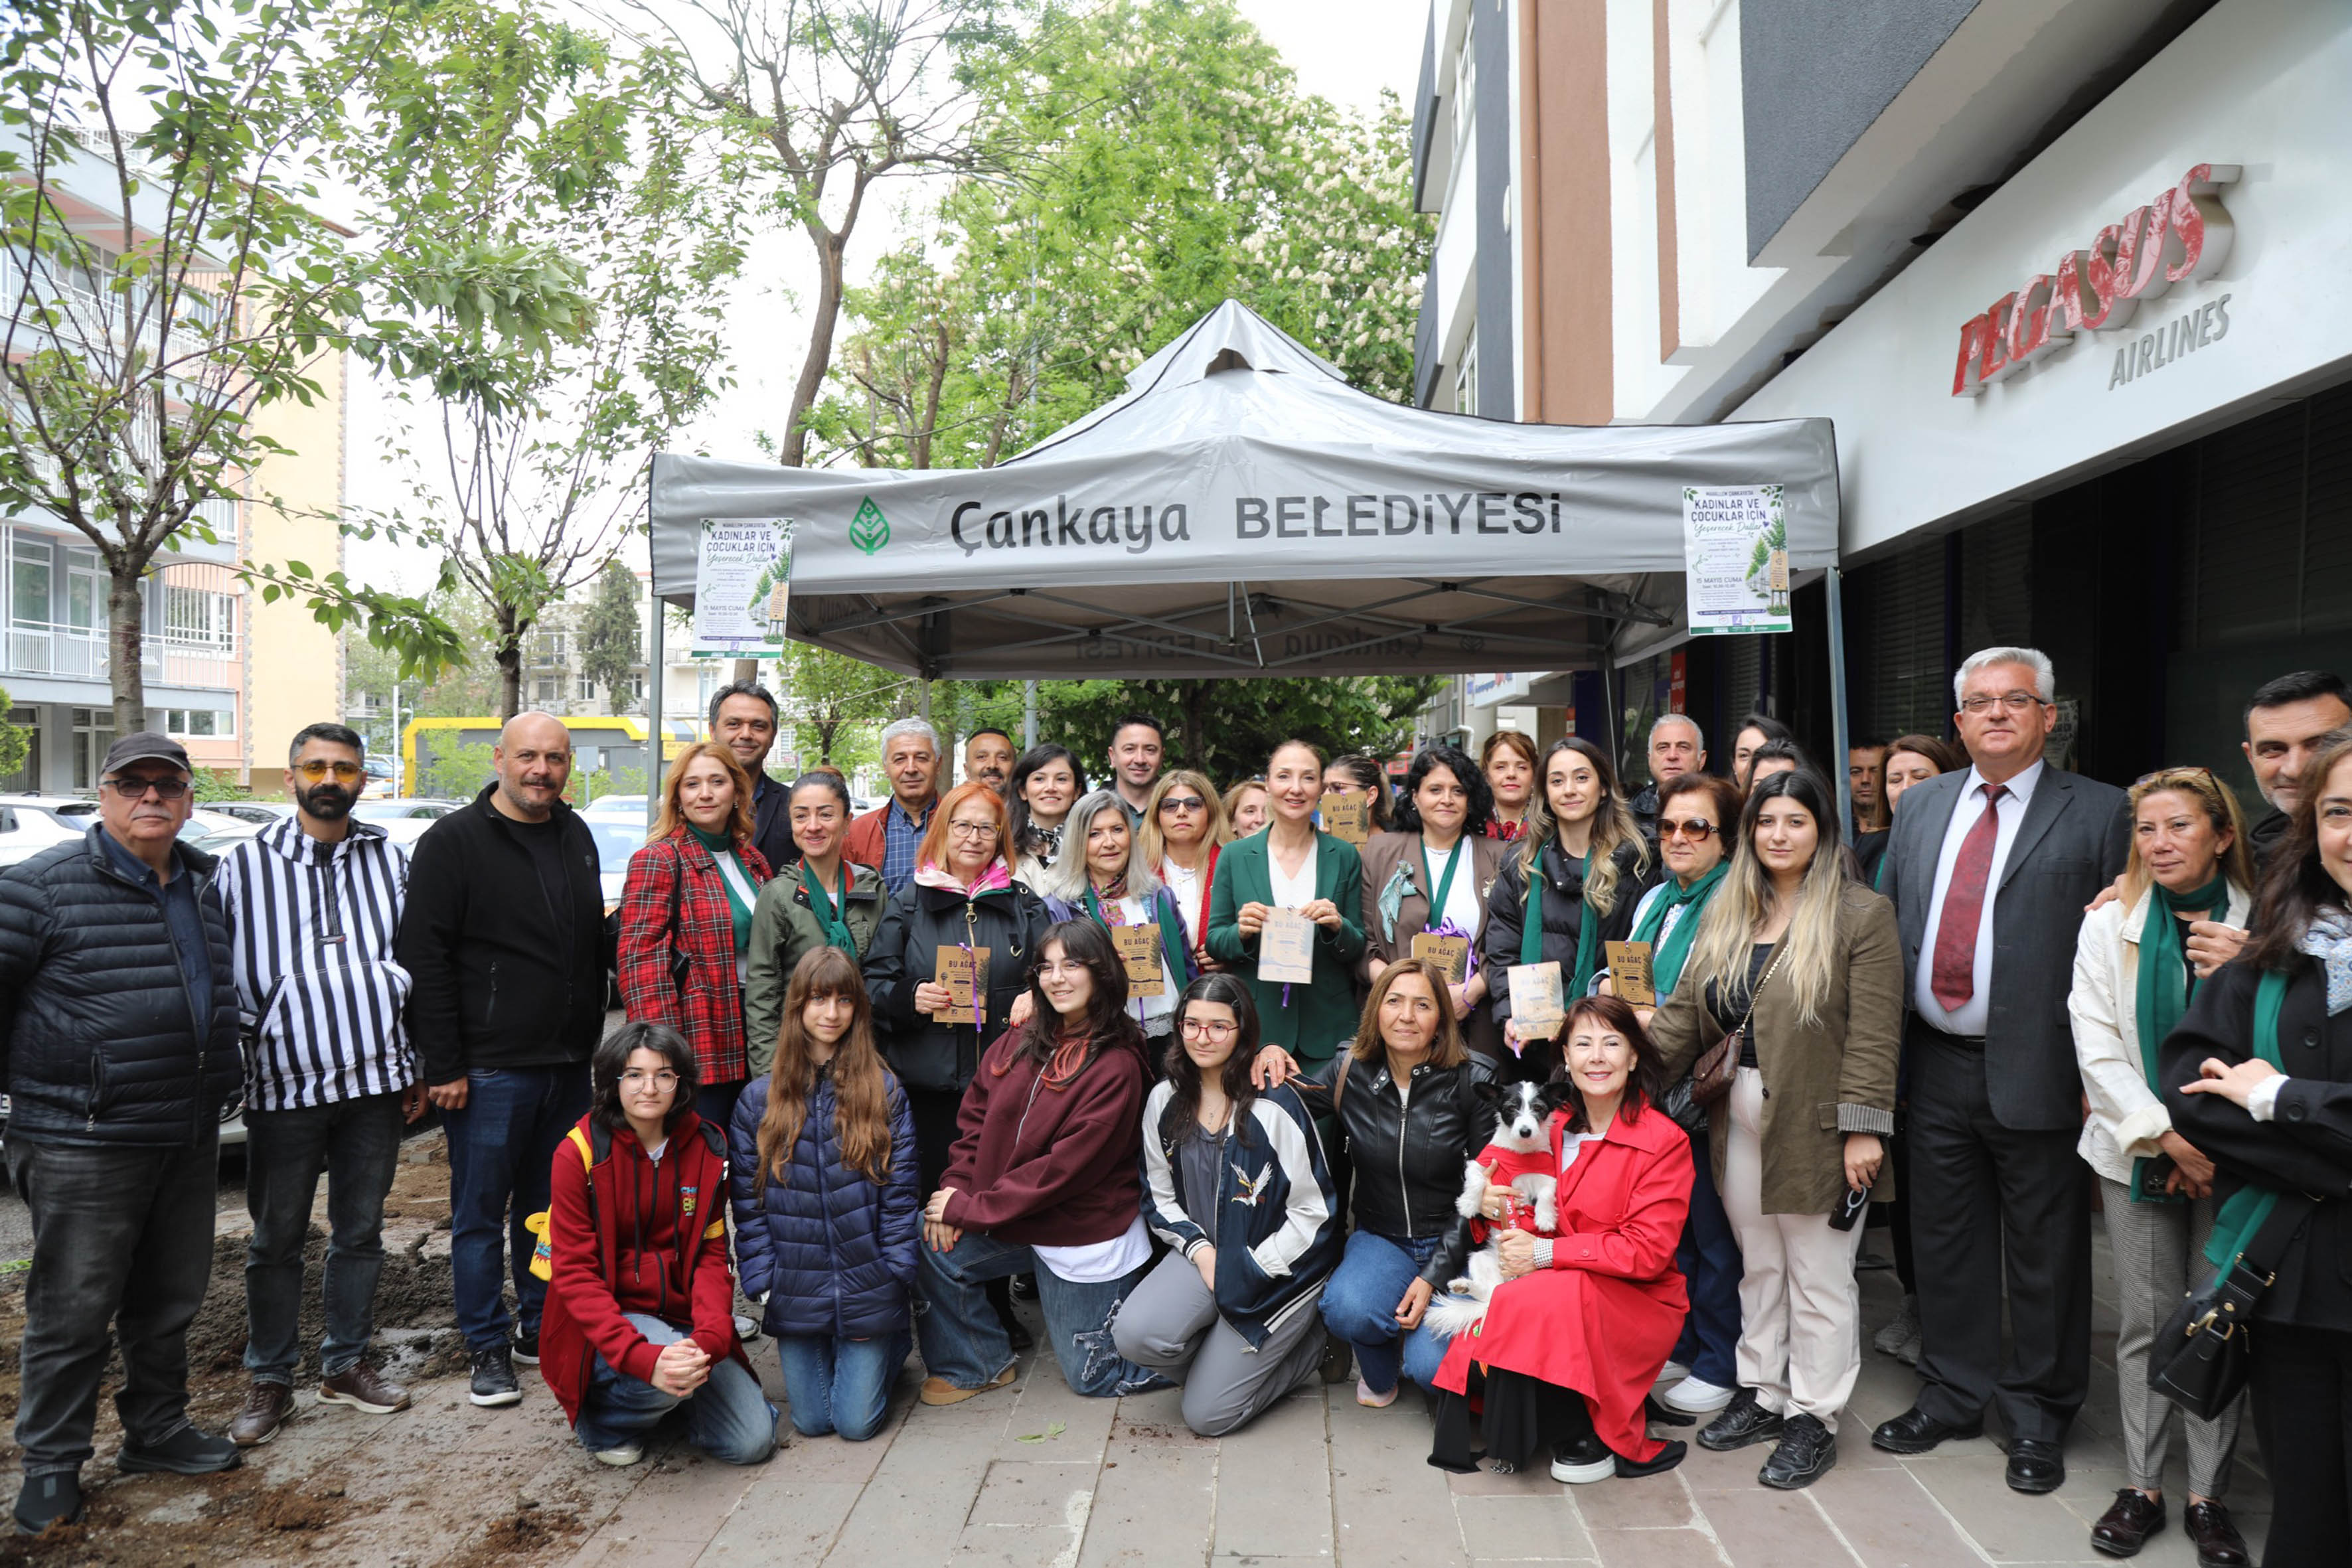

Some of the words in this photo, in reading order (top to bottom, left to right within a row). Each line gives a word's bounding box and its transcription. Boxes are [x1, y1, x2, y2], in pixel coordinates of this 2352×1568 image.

[1952, 163, 2242, 397] PEGASUS
[2108, 293, 2232, 391] AIRLINES
[1695, 499, 1743, 509] KADINLAR
[1746, 499, 1760, 509] VE
[1691, 510, 1744, 522] ÇOCUKLAR
[1747, 509, 1766, 522] İÇİN
[950, 495, 1190, 558] Çankaya
[1693, 522, 1735, 537] Yeşerecek
[1737, 521, 1762, 532] Dallar
[712, 531, 757, 541] KADINLAR
[759, 531, 771, 540] VE
[706, 542, 755, 554] ÇOCUKLAR
[757, 542, 776, 554] İÇİN
[706, 552, 744, 567] Yeşerecek
[745, 552, 770, 564] Dallar
[1438, 947, 1455, 957] AĞAÇ
